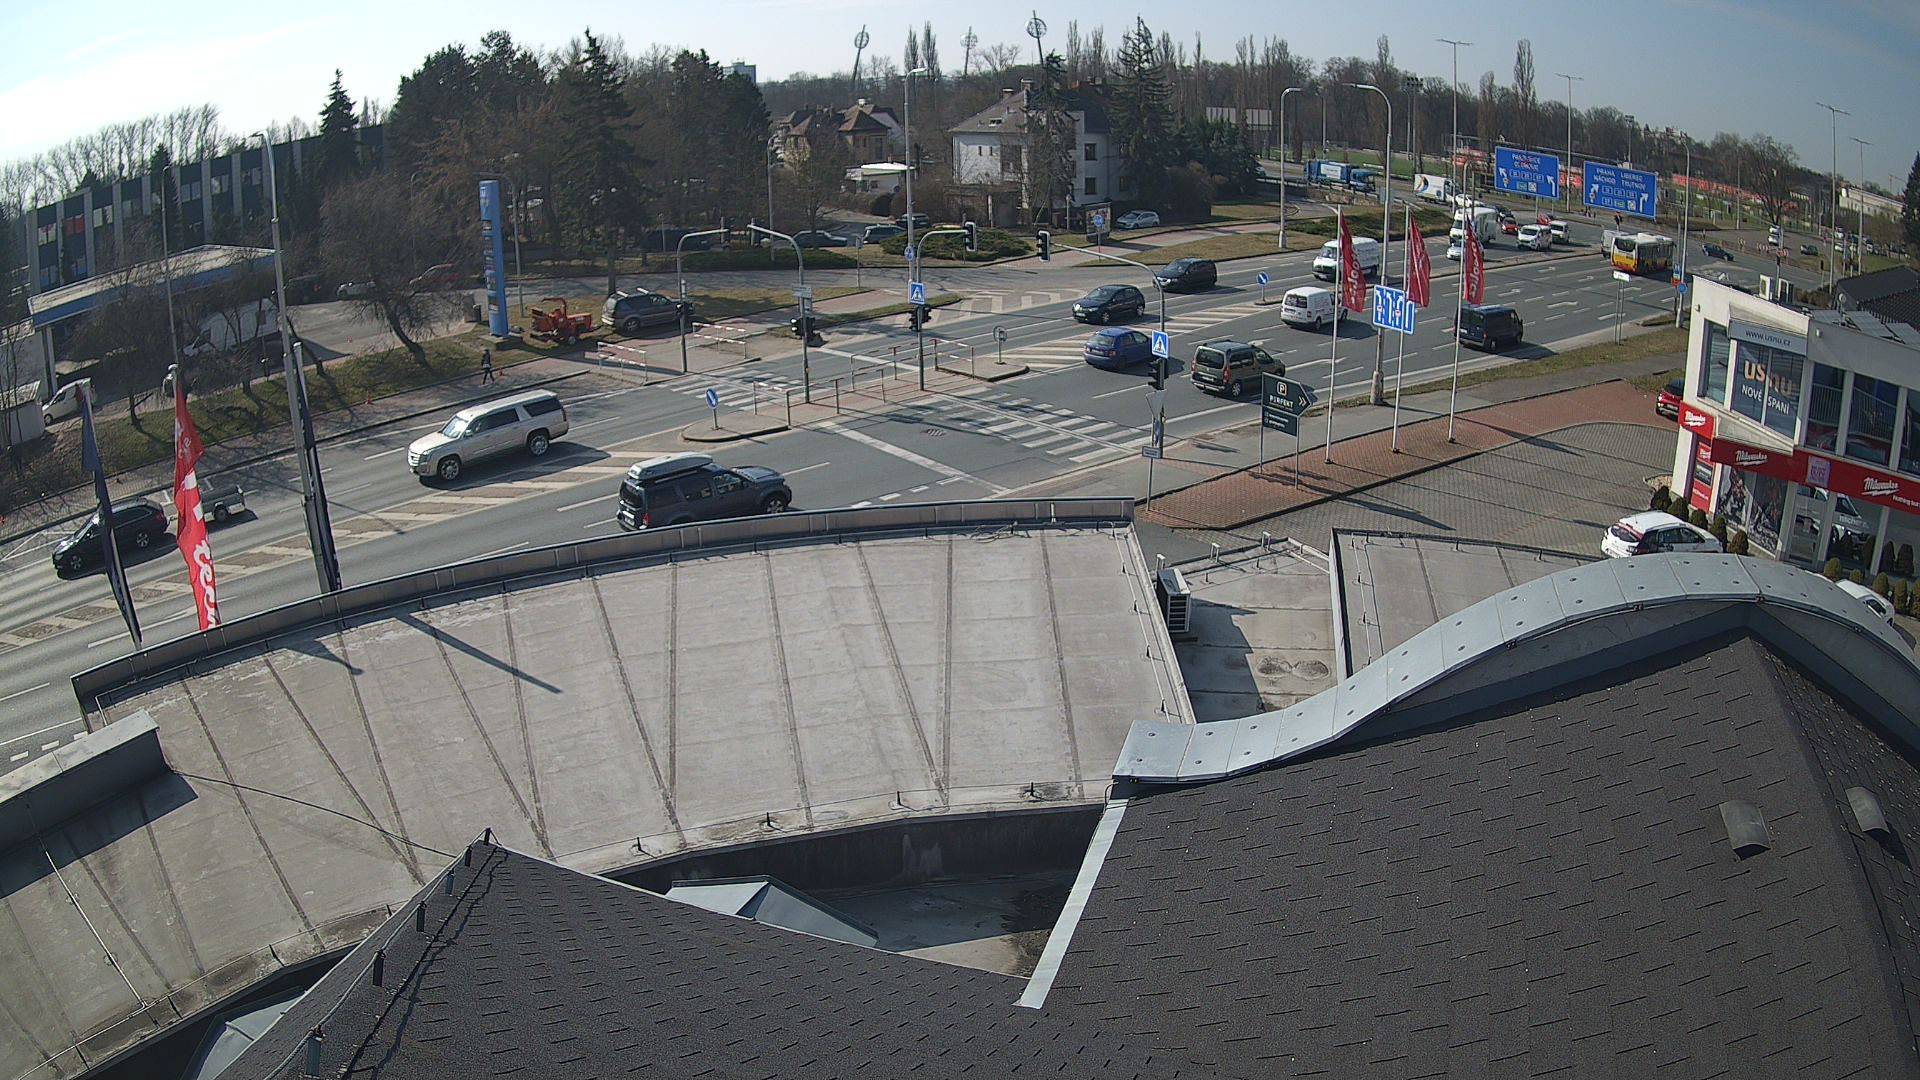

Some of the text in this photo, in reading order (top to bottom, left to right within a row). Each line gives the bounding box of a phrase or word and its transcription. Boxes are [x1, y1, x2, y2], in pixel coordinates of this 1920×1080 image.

[1745, 330, 1791, 346] www.usnu.cz
[1741, 383, 1763, 402] NOVÉ
[1269, 395, 1294, 407] PERFEKT
[1735, 450, 1768, 462] Milwaukee
[1863, 476, 1899, 491] Milwaukee
